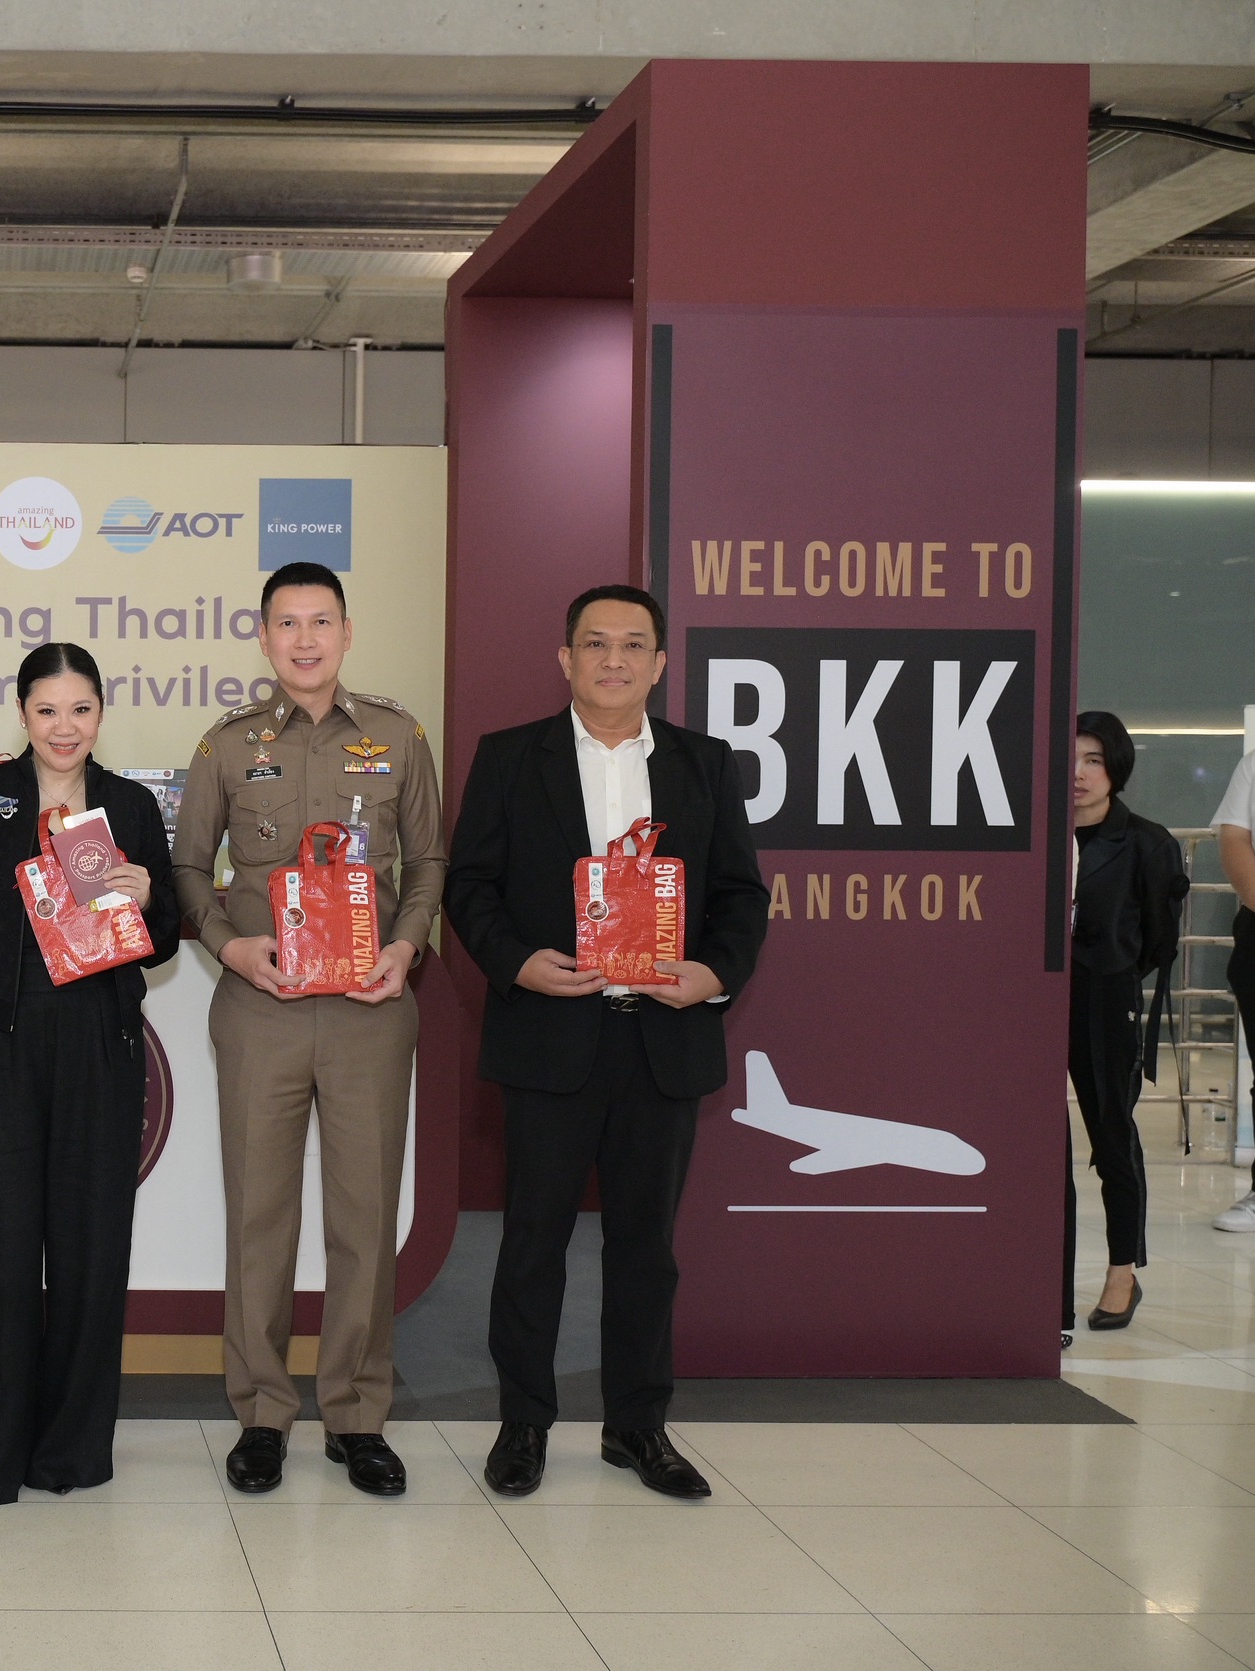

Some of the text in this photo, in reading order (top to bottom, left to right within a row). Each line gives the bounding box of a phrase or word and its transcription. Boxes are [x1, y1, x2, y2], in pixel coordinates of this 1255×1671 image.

[17, 506, 55, 517] amazing
[162, 512, 244, 539] AOT
[267, 523, 343, 534] KING POWER
[692, 540, 1033, 599] WELCOME TO
[75, 595, 262, 640] Thaila
[707, 658, 1019, 827] BKK
[347, 871, 369, 906] BAG
[654, 863, 677, 898] BAG
[768, 873, 983, 921] ANGKOK
